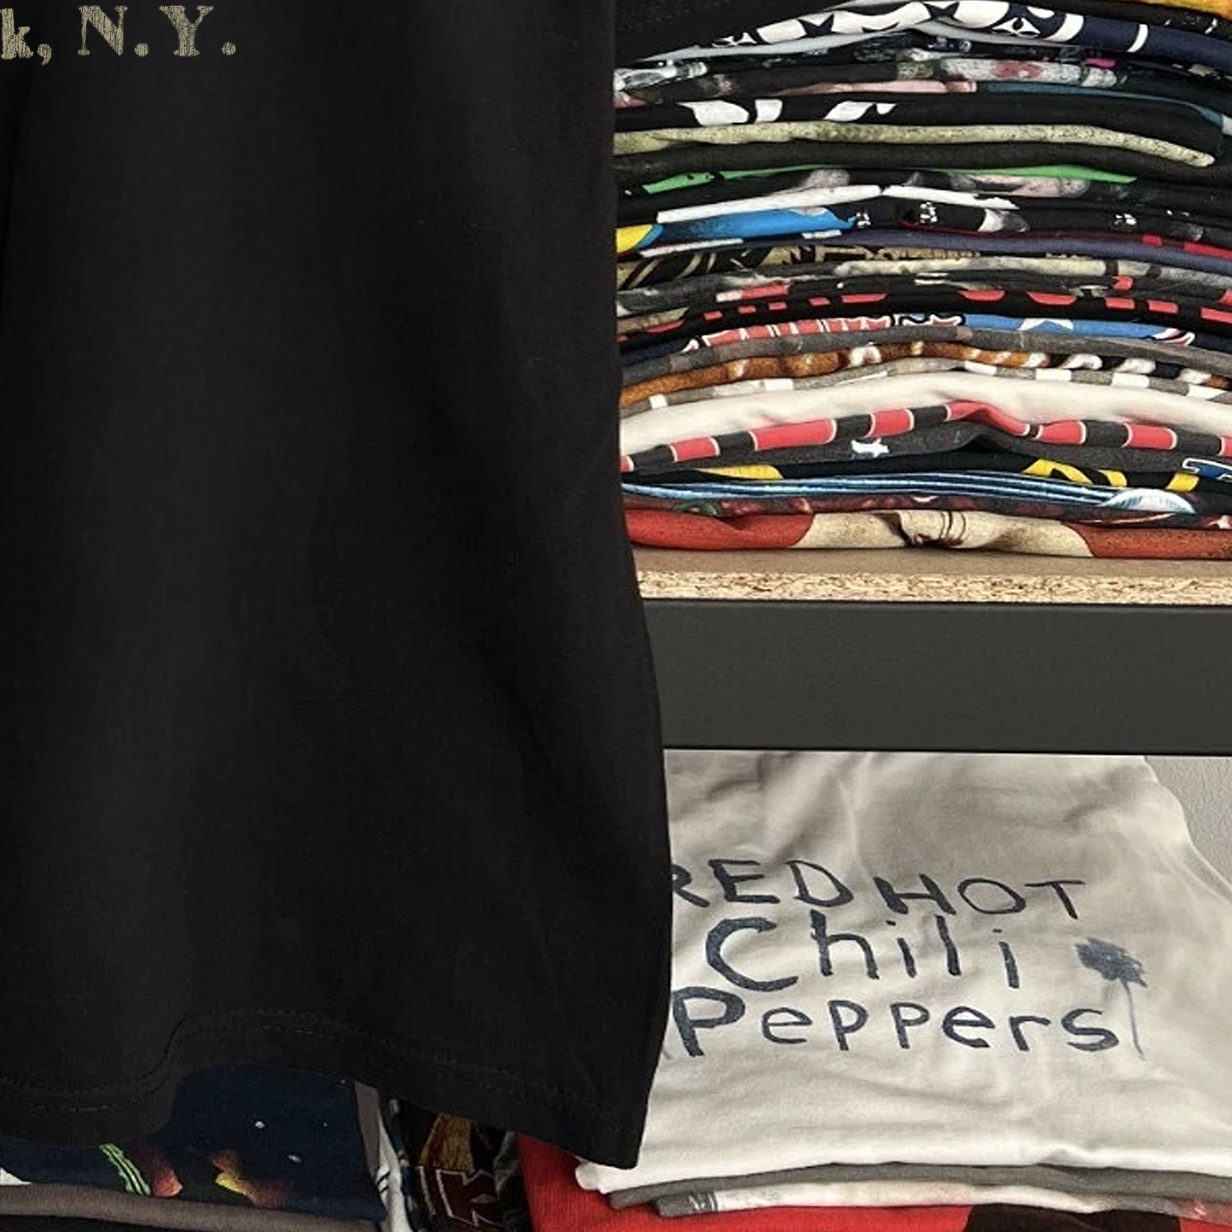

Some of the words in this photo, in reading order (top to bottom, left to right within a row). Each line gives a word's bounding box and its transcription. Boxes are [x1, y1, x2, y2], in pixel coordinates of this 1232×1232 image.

[671, 859, 854, 908] RED
[873, 873, 1086, 919] HOT
[705, 909, 1020, 992] Chili
[672, 985, 1121, 1057] Peppers
